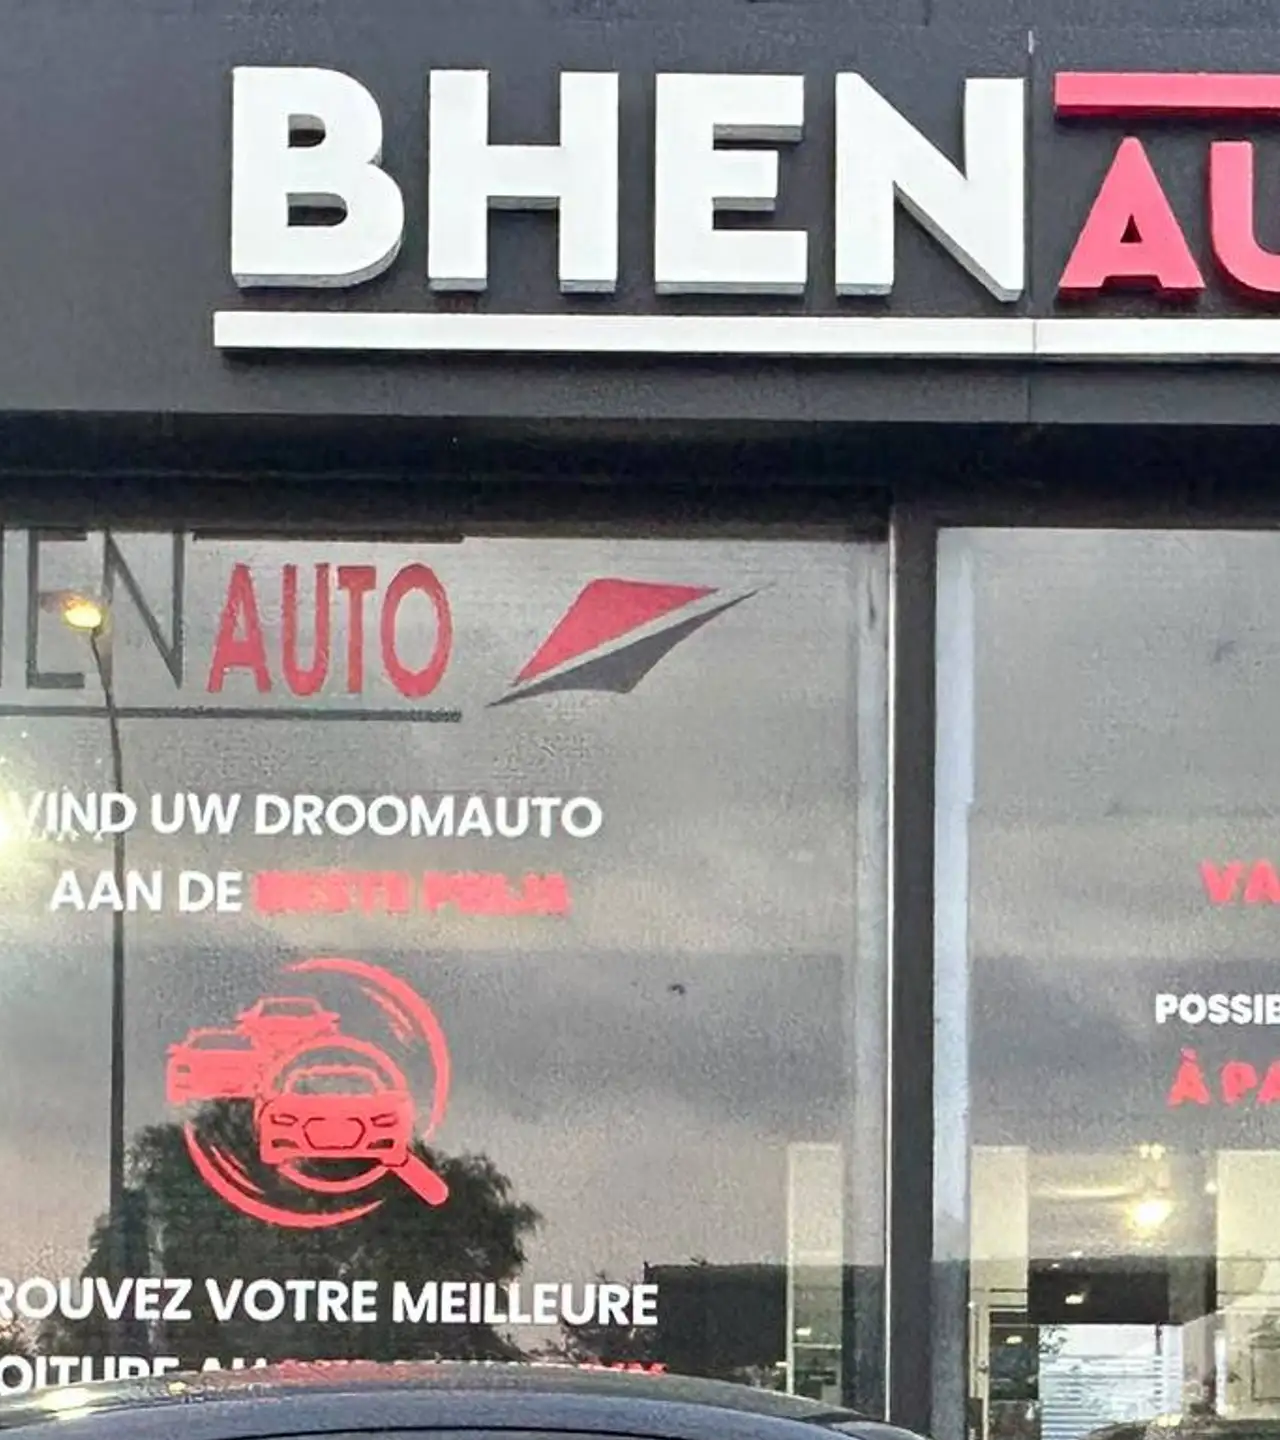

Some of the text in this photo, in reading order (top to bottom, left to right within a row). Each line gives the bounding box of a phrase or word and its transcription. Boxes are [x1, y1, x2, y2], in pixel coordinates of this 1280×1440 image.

[10, 792, 604, 838] VIND UW DROOMAUTO
[50, 871, 164, 912] AAN
[179, 871, 243, 912] DE
[207, 1278, 379, 1325] VOTRE
[393, 1280, 659, 1327] MEILLEURE
